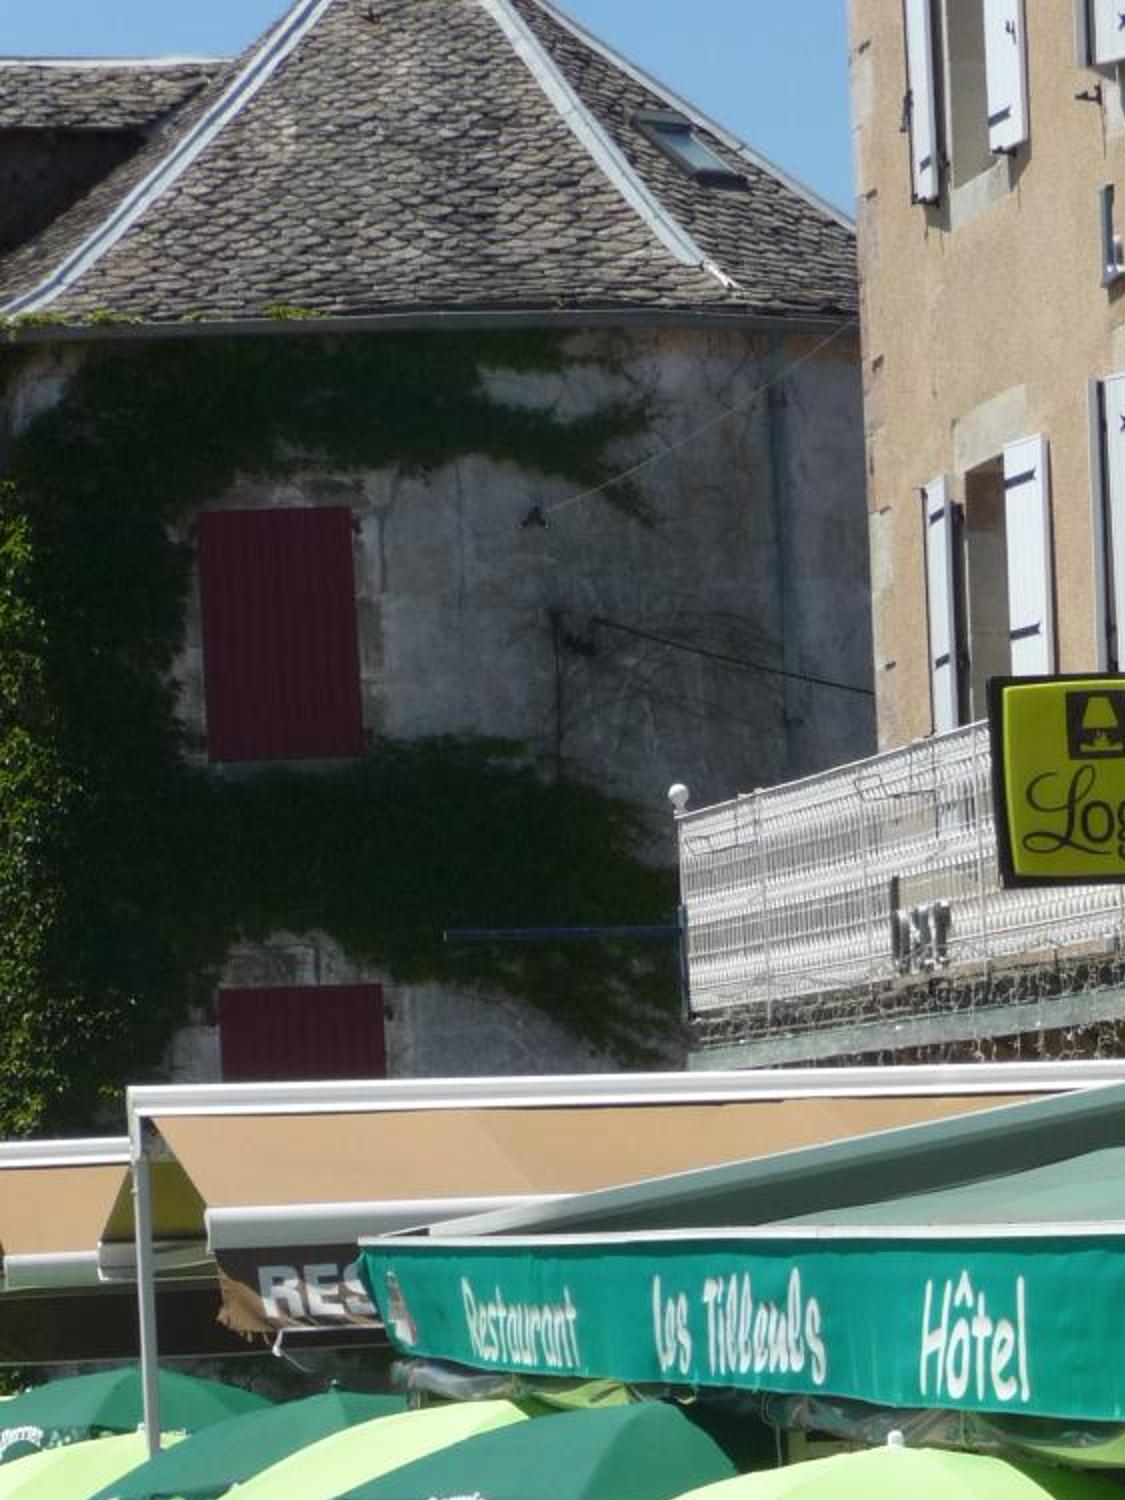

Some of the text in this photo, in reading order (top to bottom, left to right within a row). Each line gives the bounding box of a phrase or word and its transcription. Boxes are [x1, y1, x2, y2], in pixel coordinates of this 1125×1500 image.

[461, 1275, 581, 1368] Restaurant
[652, 1274, 692, 1376] Les
[919, 1268, 1031, 1403] Hôtel
